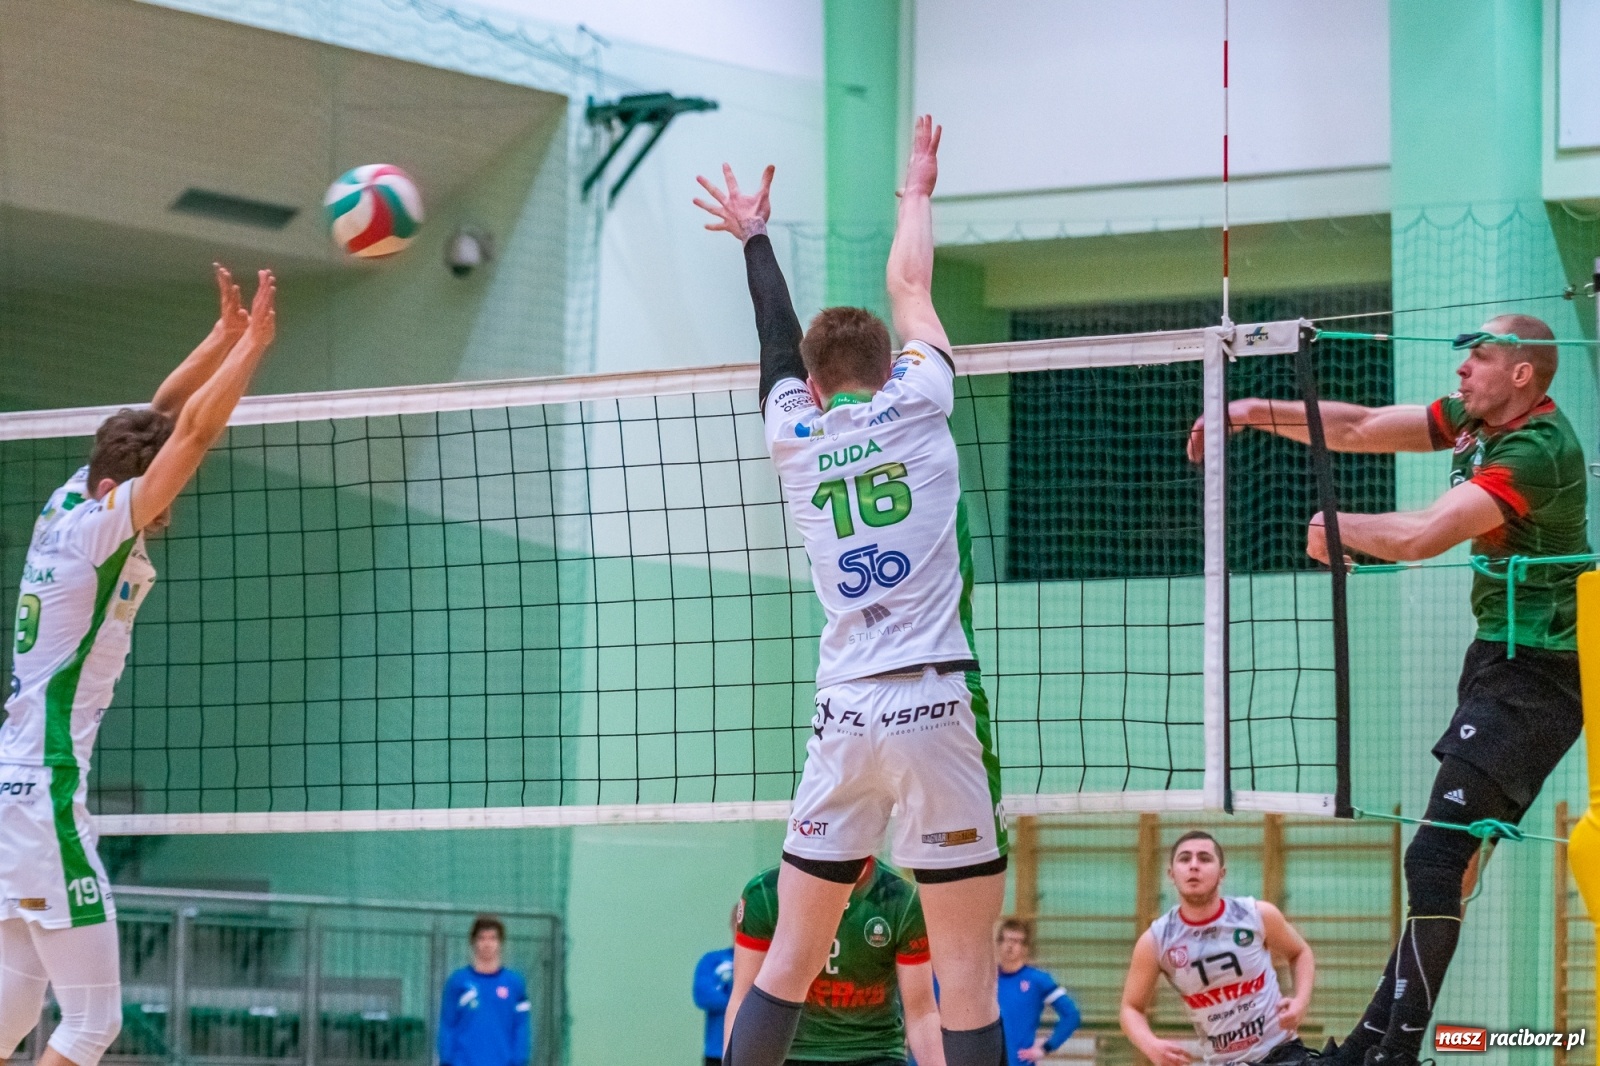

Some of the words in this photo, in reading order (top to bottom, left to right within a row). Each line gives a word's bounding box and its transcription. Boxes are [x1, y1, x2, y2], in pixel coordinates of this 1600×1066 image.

[818, 438, 882, 472] DUDA
[811, 462, 913, 539] 16
[837, 543, 911, 599] STO
[848, 622, 914, 645] STILMAR
[0, 782, 37, 796] POT
[68, 876, 100, 907] 19
[1190, 951, 1243, 987] 17
